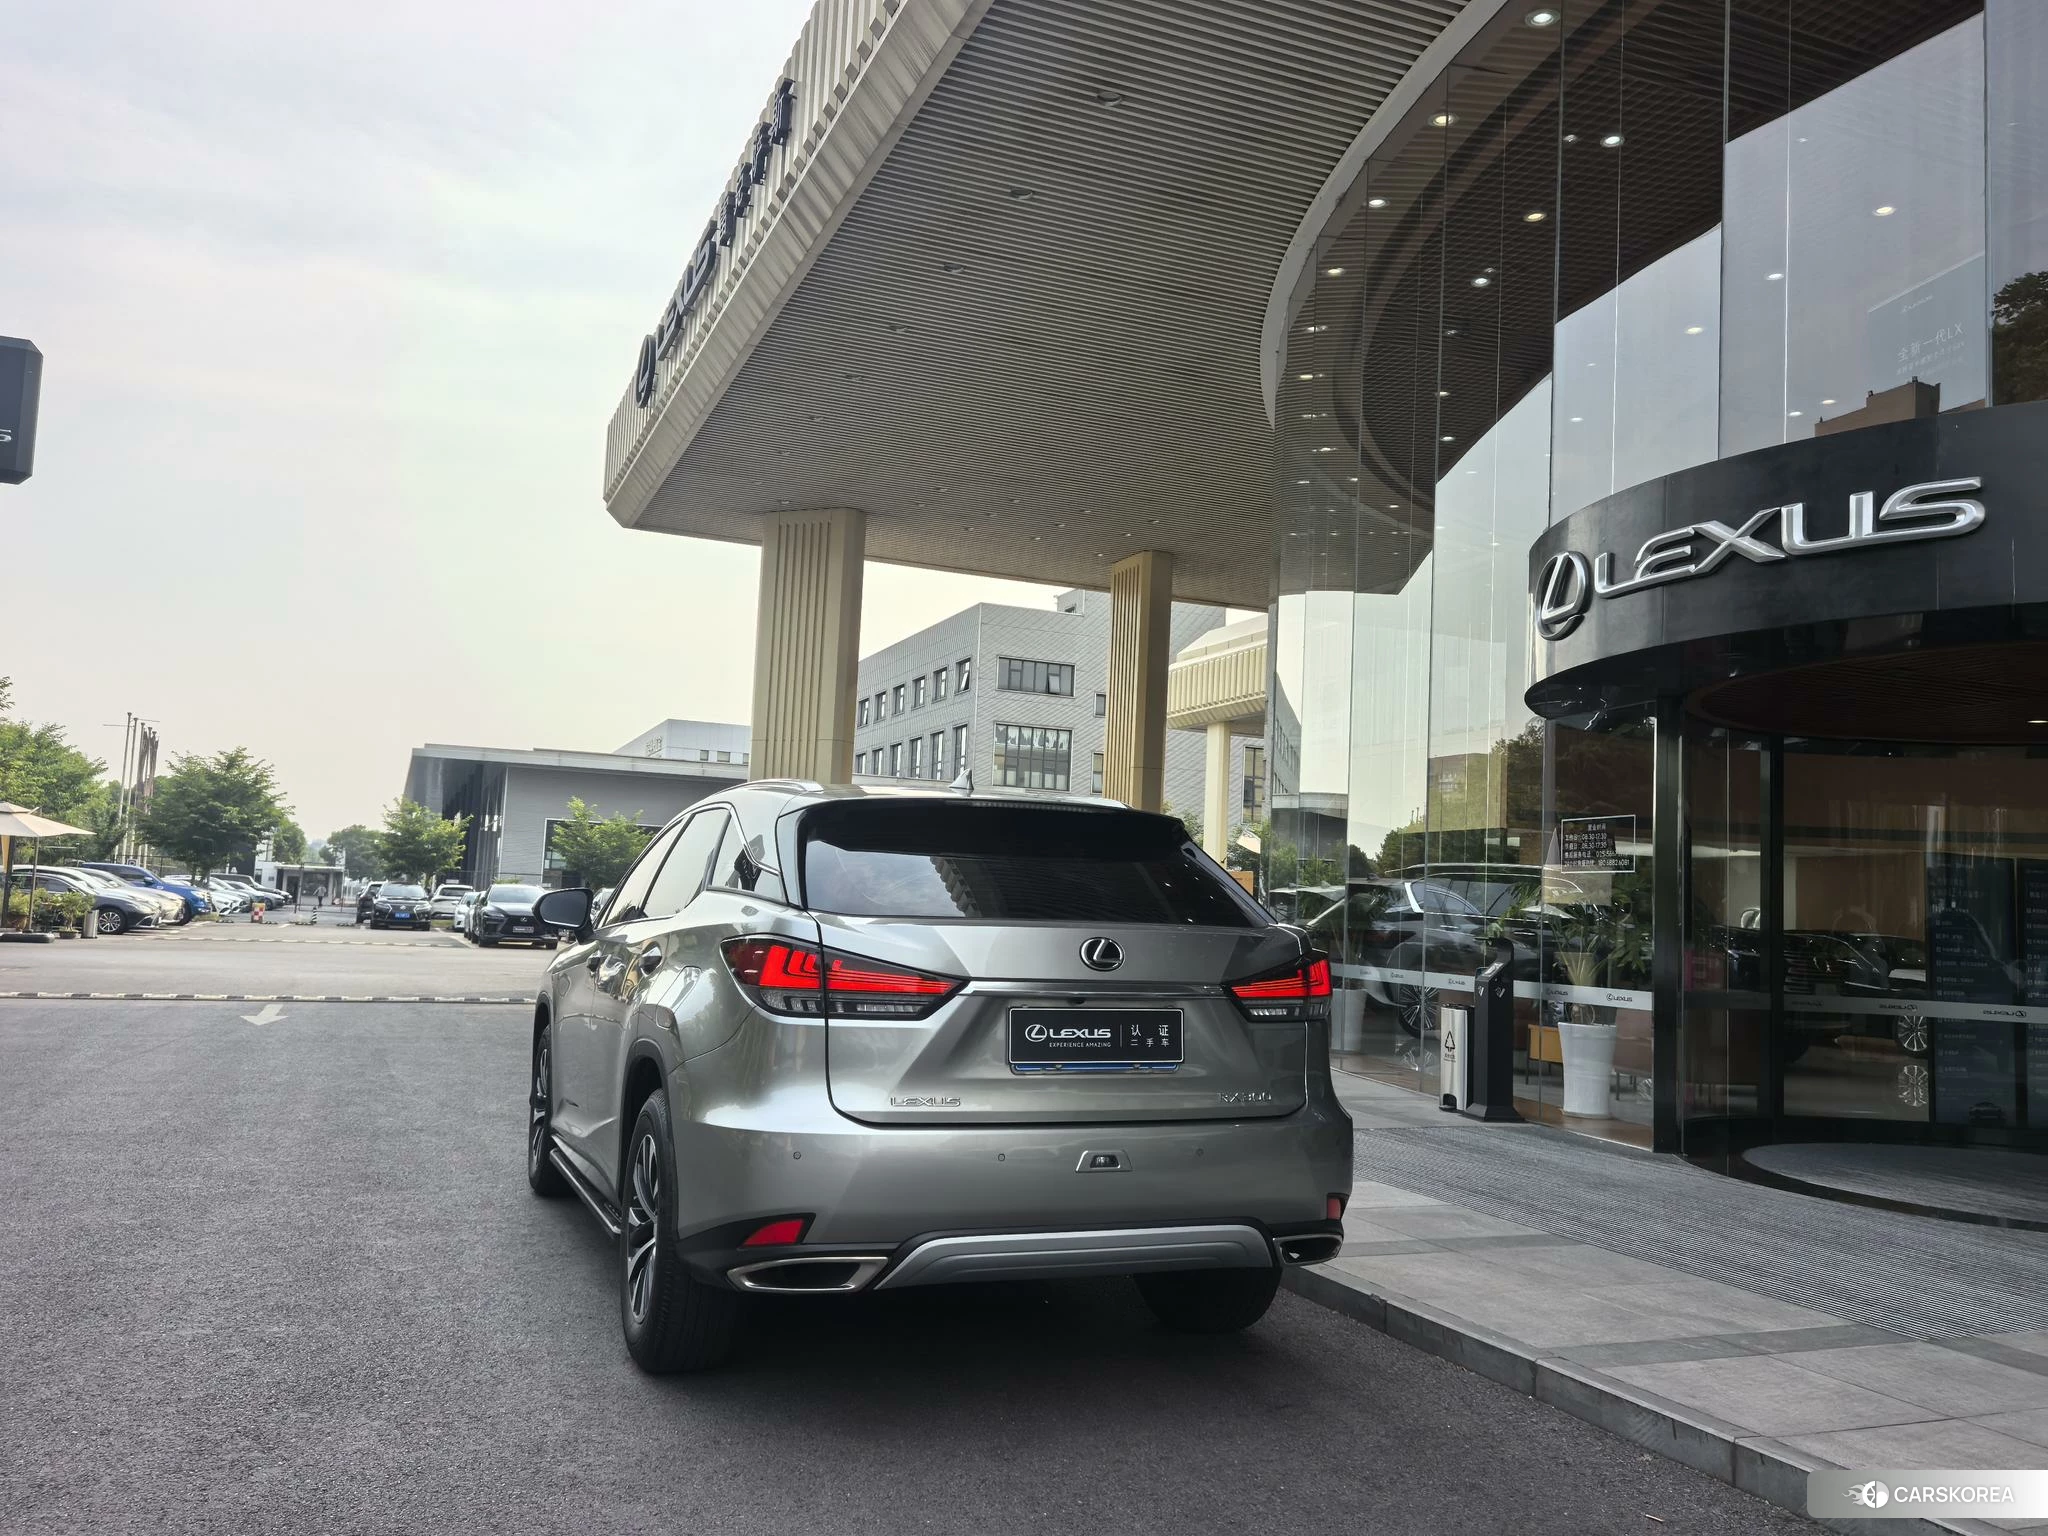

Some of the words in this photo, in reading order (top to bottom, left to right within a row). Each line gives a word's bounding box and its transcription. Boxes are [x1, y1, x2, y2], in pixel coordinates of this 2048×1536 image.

[1594, 475, 1987, 600] LEXUS
[1049, 1028, 1111, 1039] LEXUS
[890, 1096, 961, 1107] LEXUS
